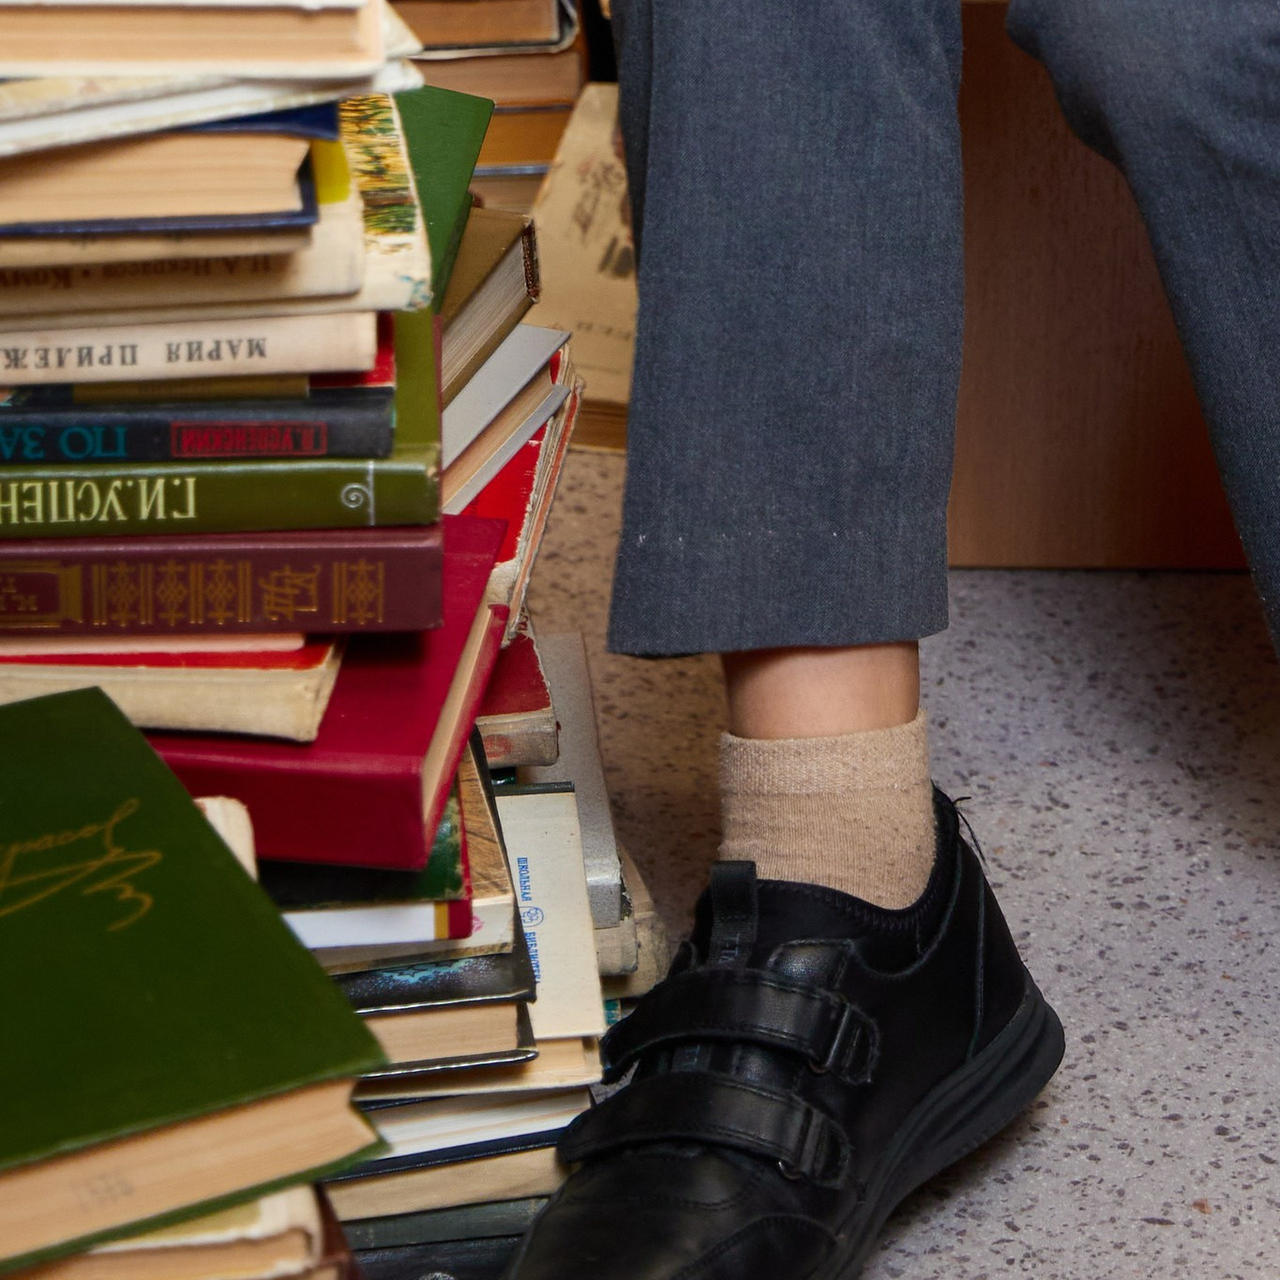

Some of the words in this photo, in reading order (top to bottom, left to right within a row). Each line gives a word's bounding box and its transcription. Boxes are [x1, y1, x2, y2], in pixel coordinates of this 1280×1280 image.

[2, 343, 139, 370] ПРИЛЕЖ
[166, 337, 267, 363] МАРИЯ
[59, 425, 129, 459] ПО
[516, 856, 532, 902] ШКОЛЬНАЯ
